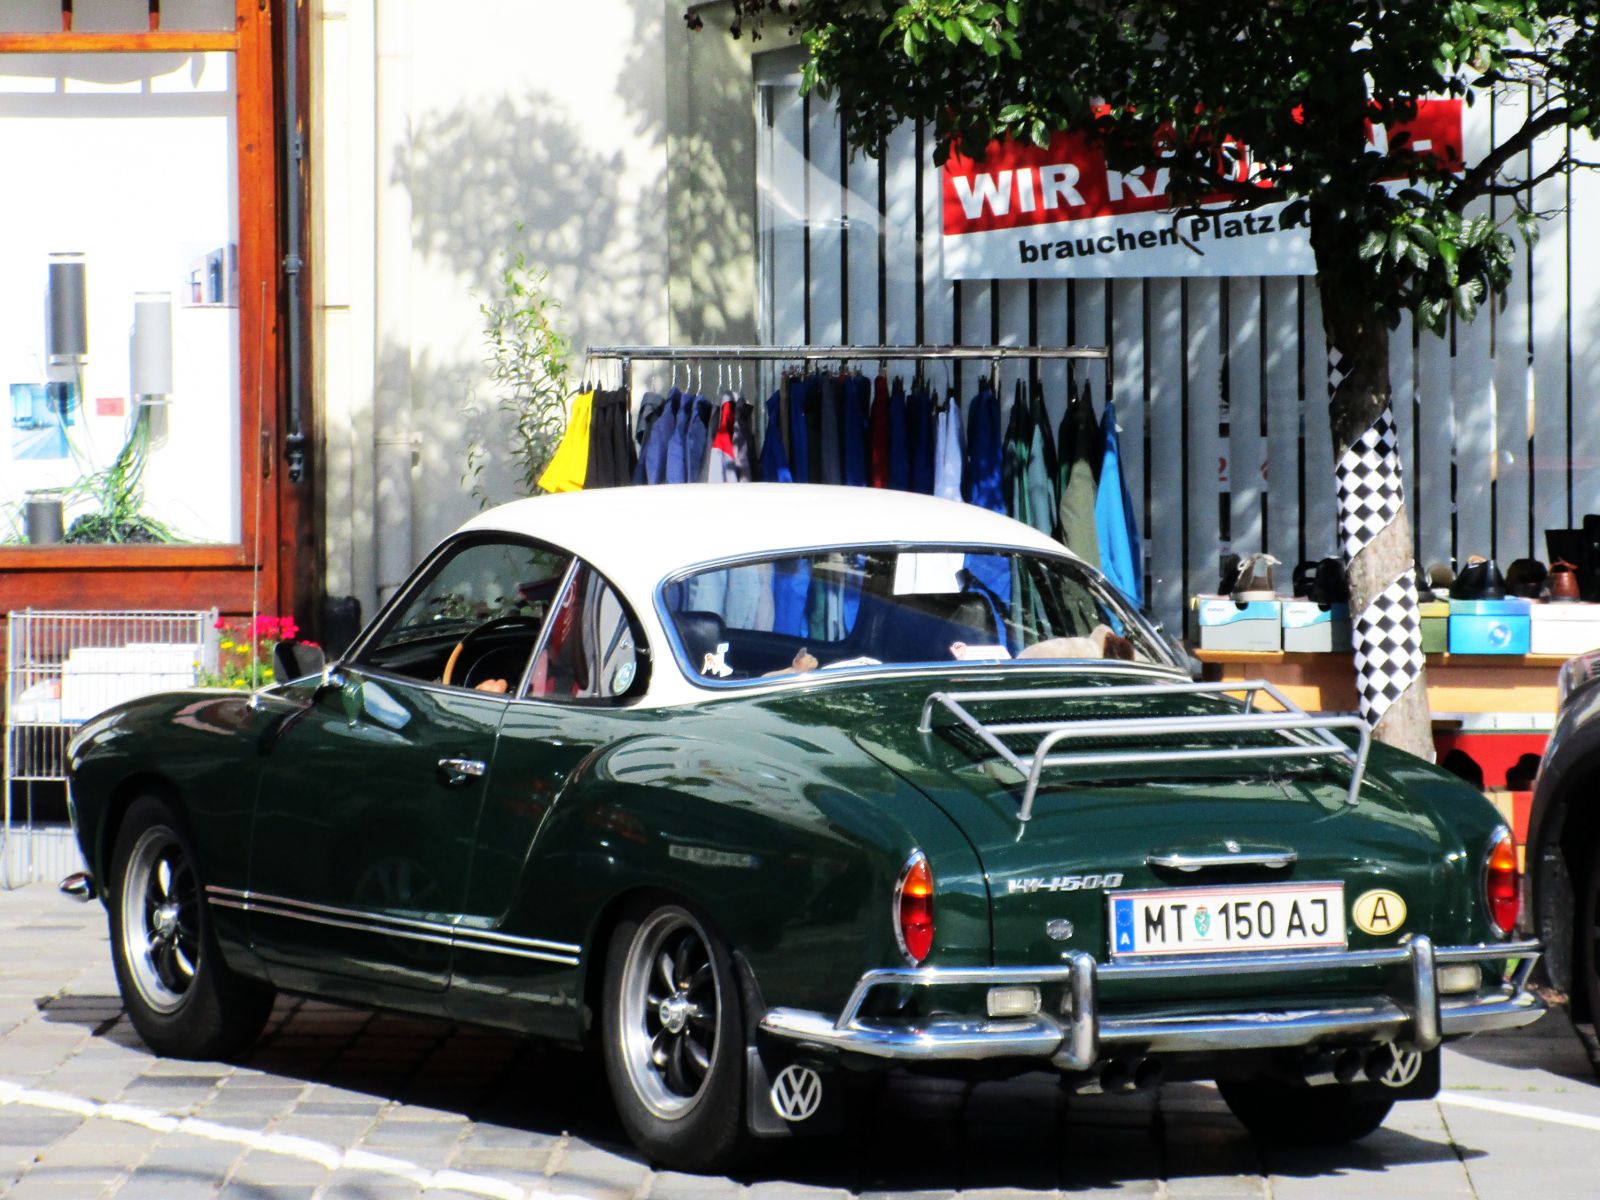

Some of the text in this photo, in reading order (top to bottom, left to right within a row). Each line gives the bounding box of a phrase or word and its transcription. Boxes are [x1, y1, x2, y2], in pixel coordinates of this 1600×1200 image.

[952, 163, 1086, 219] WIR
[1019, 228, 1179, 263] brauchen
[1190, 213, 1275, 242] Platz
[1144, 898, 1328, 943] MT 150 AJ
[1369, 896, 1392, 929] A
[1120, 932, 1131, 945] A
[771, 1064, 822, 1121] VW
